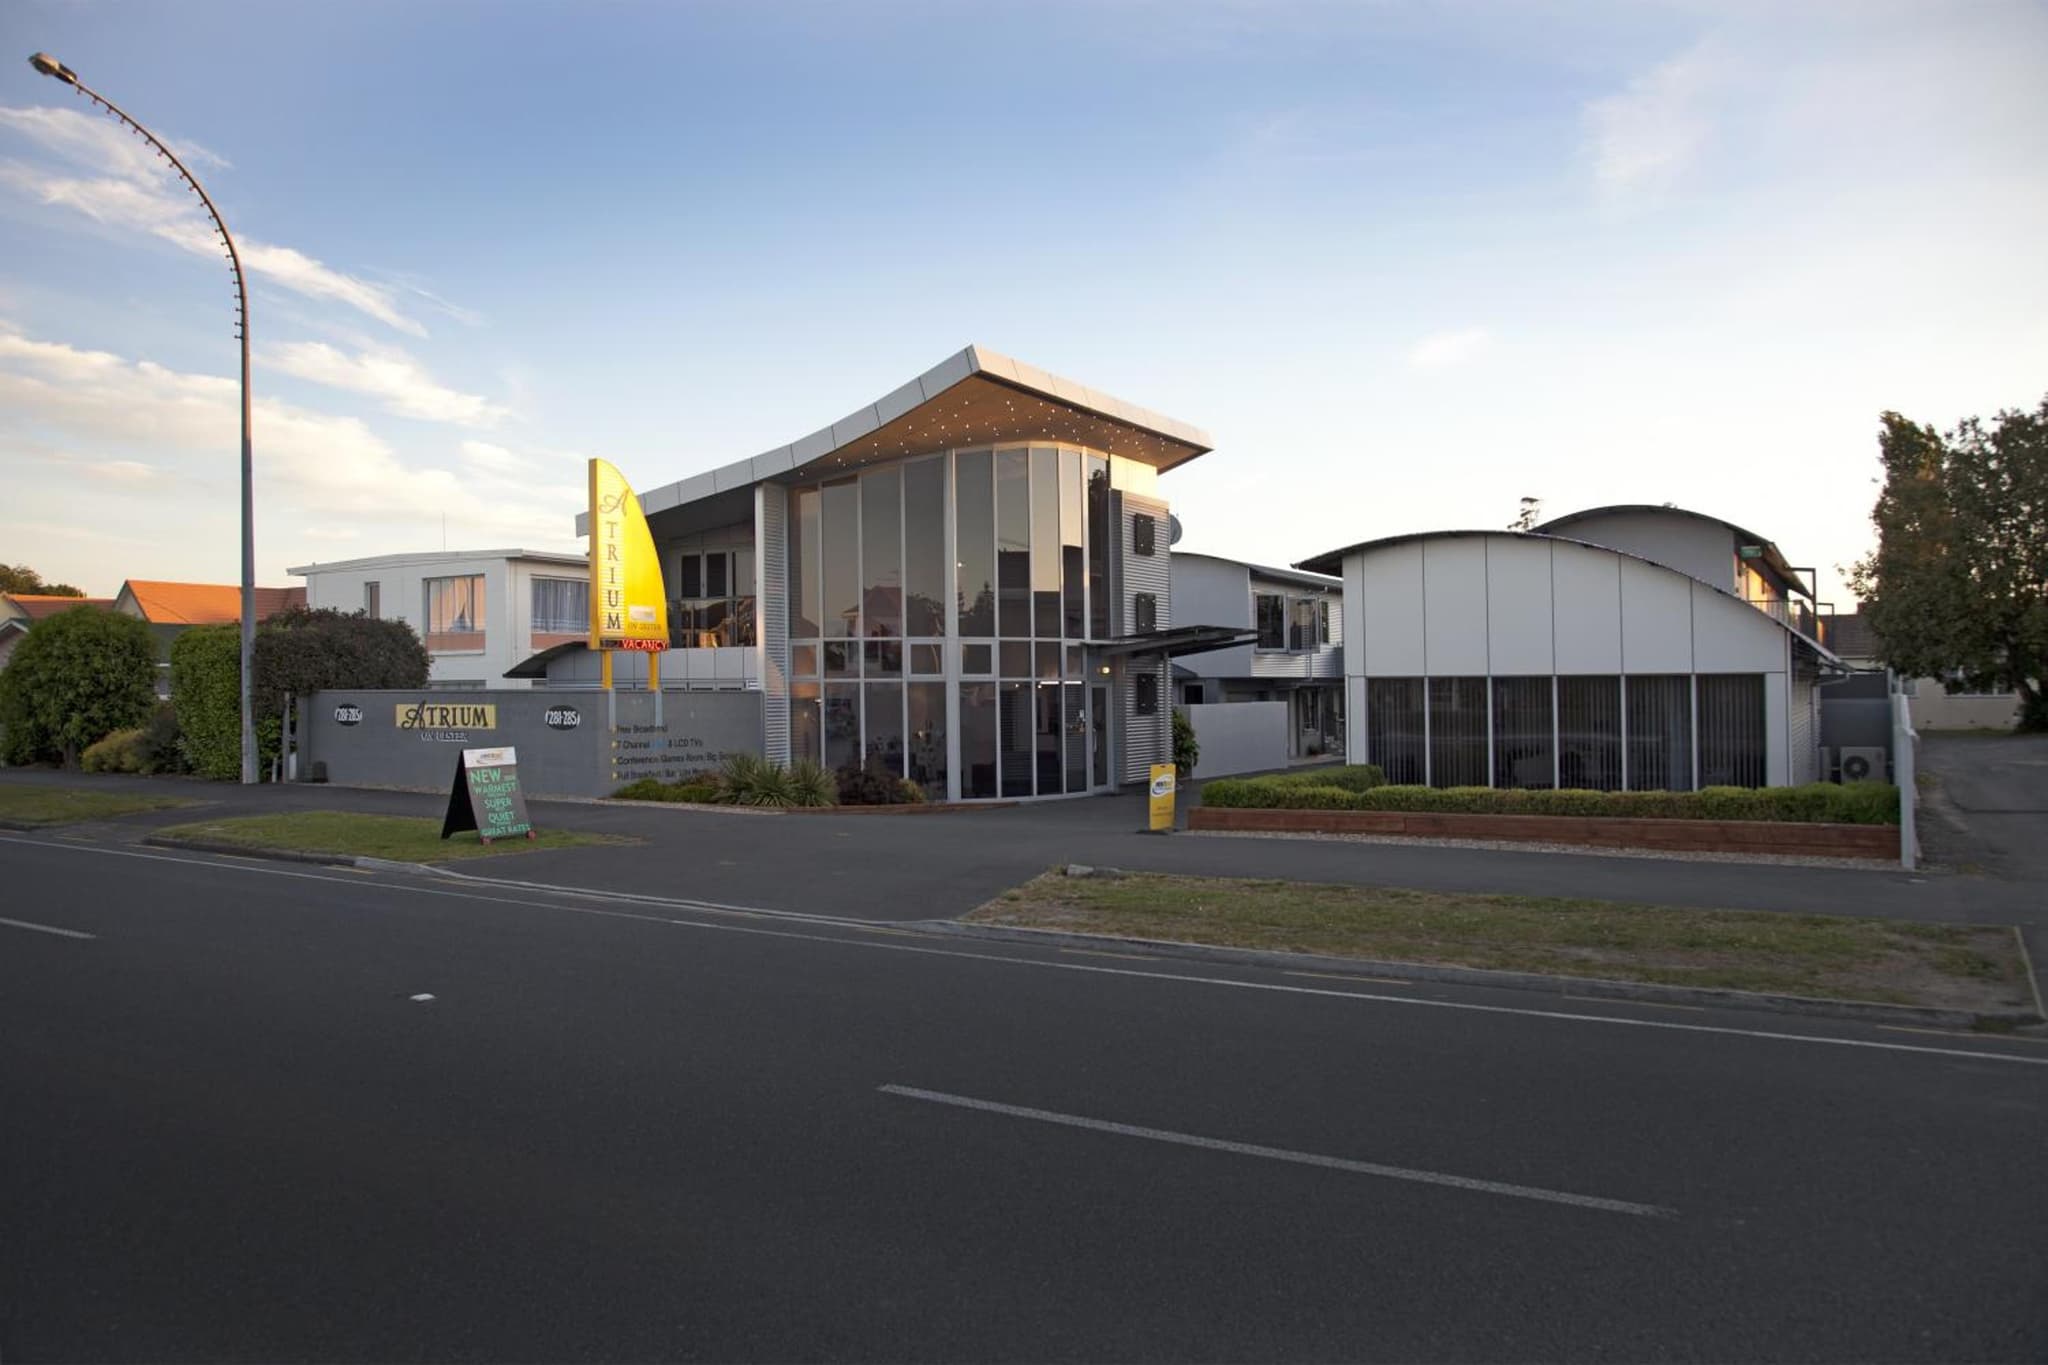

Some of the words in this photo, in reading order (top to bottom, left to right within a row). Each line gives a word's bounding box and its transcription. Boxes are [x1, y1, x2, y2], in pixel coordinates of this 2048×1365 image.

[599, 489, 629, 629] ATRIUM
[623, 639, 667, 649] VACANCY
[402, 700, 489, 730] ATRIUM
[470, 768, 501, 784] NEW
